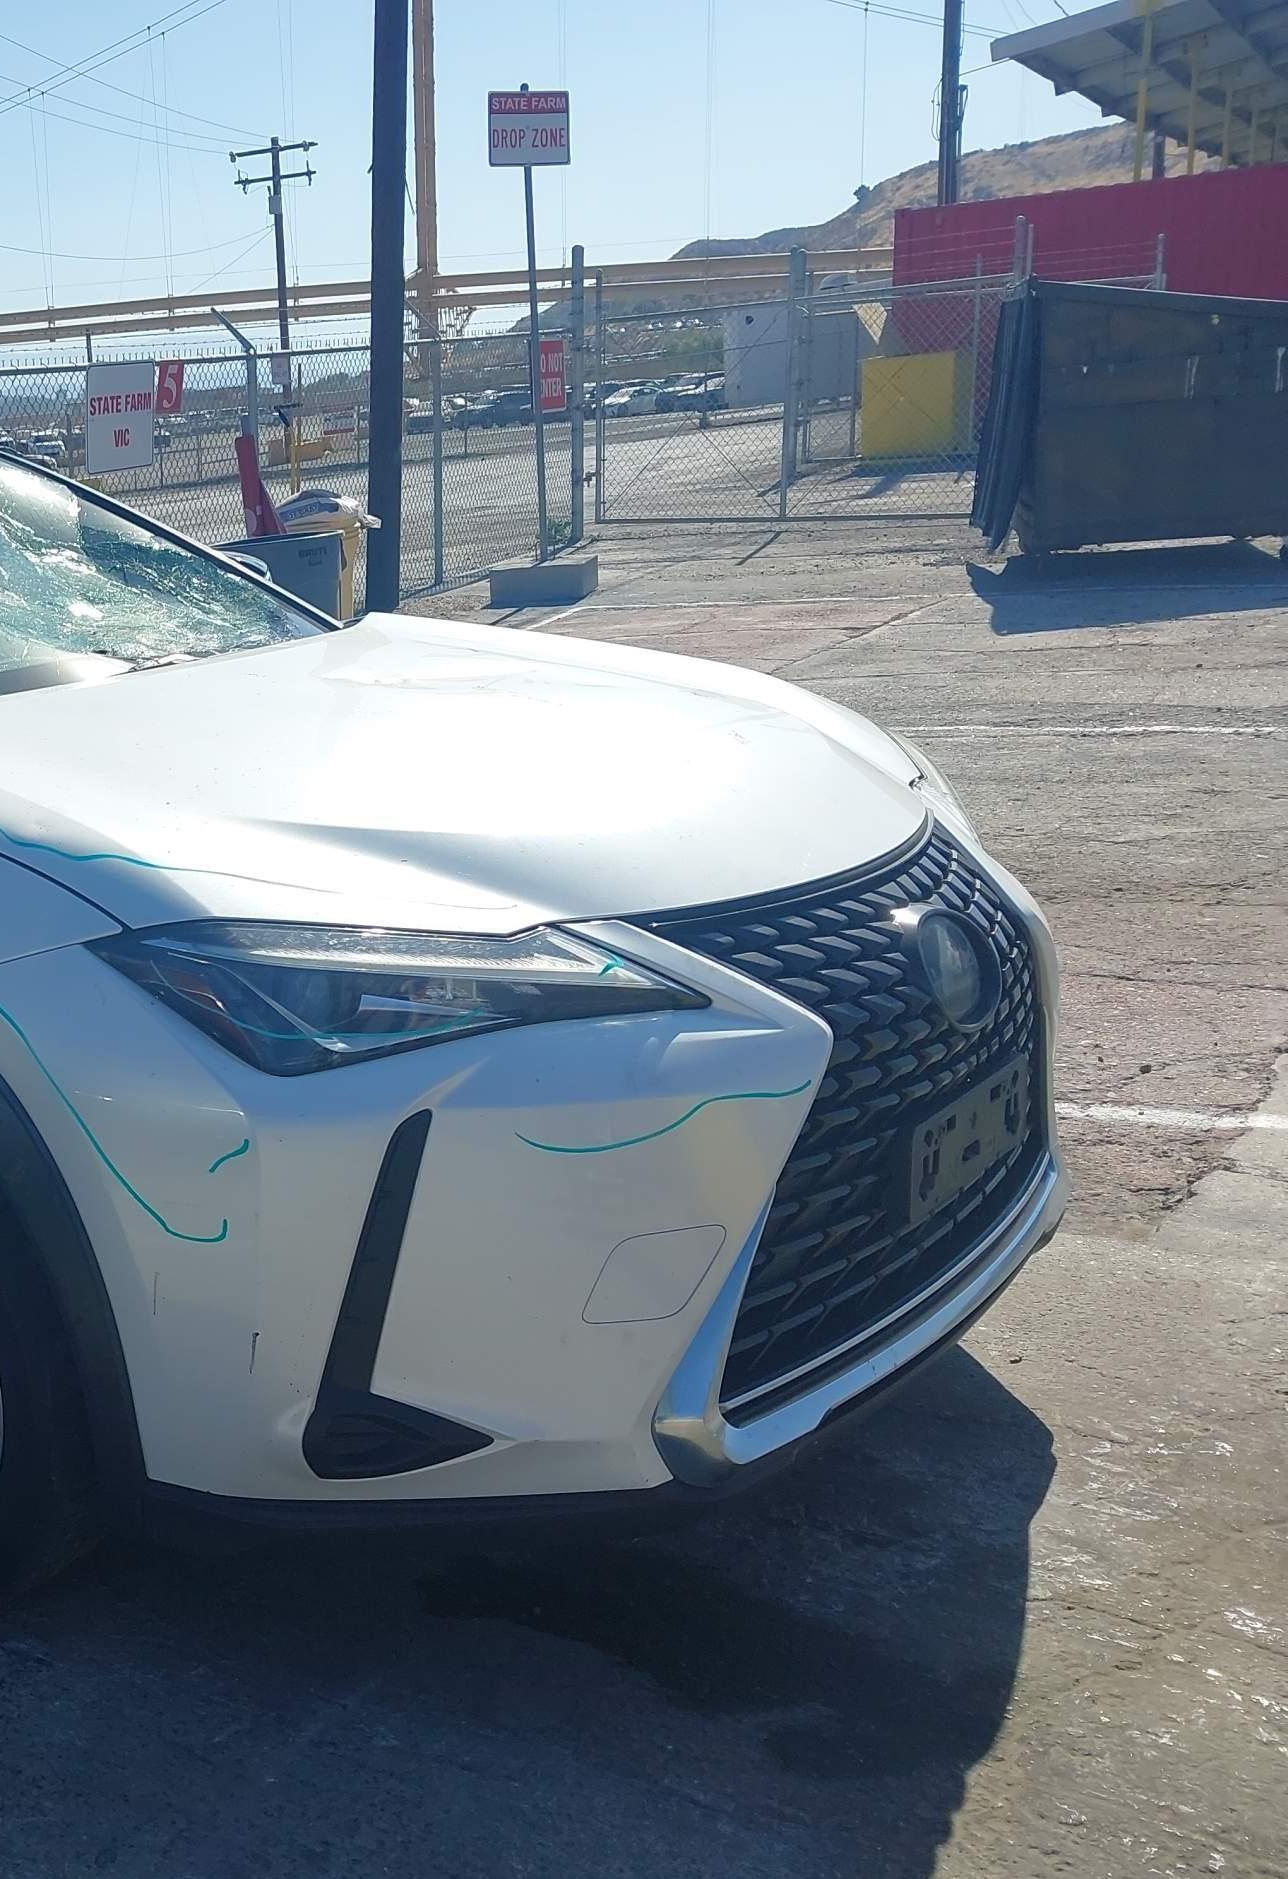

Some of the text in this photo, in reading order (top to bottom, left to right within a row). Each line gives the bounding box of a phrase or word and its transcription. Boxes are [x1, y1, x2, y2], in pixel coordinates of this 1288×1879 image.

[492, 97, 566, 110] STATE FARM
[492, 127, 566, 149] DROP ZONE
[548, 352, 563, 373] NOT
[162, 365, 179, 408] 5
[540, 377, 562, 399] NTER
[90, 392, 151, 415] STATE FARM
[114, 428, 131, 447] VIC
